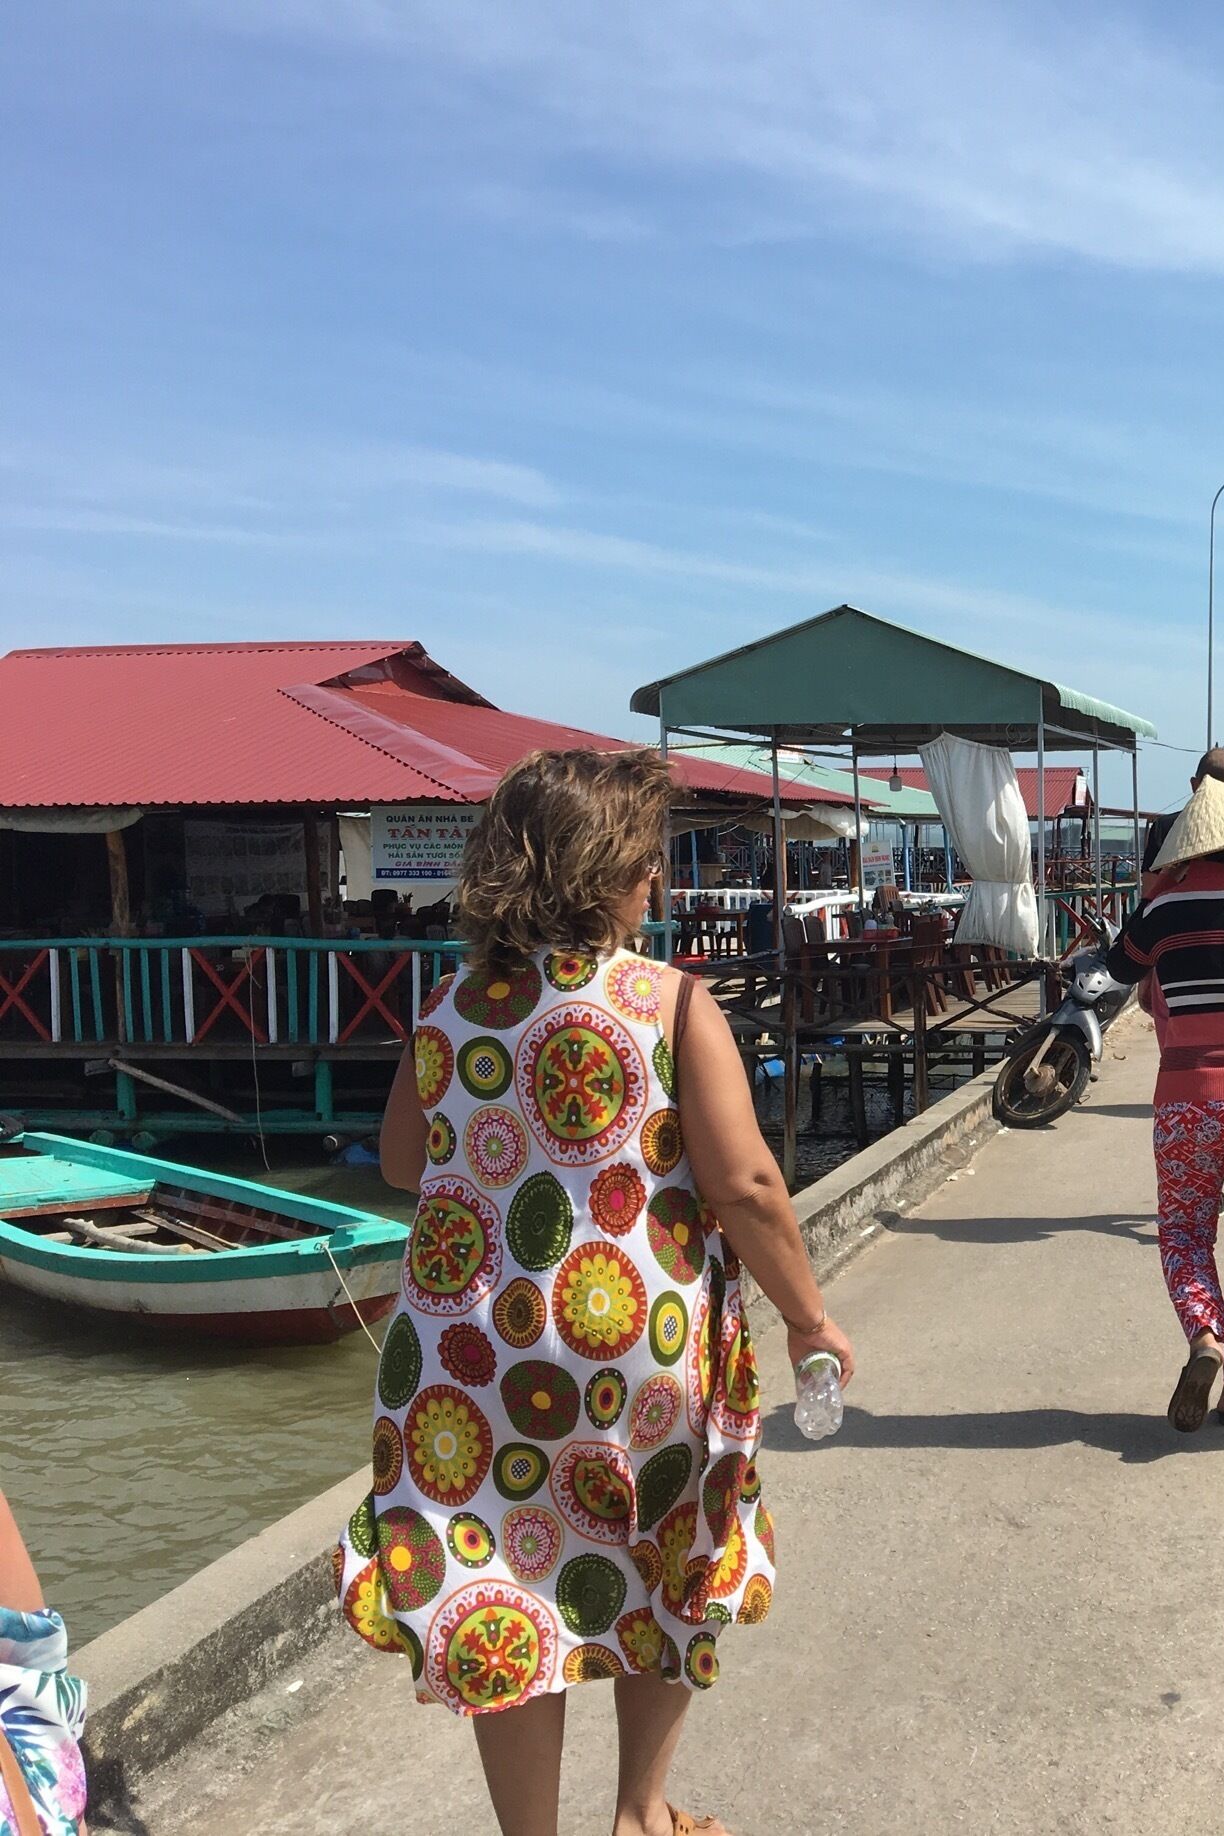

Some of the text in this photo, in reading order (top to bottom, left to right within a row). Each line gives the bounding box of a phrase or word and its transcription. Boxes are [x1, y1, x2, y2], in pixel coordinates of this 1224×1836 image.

[386, 814, 415, 823] QUÁN
[387, 824, 432, 839] TẤN
[423, 842, 441, 850] CÁC
[388, 851, 403, 859] HẢI
[406, 851, 423, 859] SẢN
